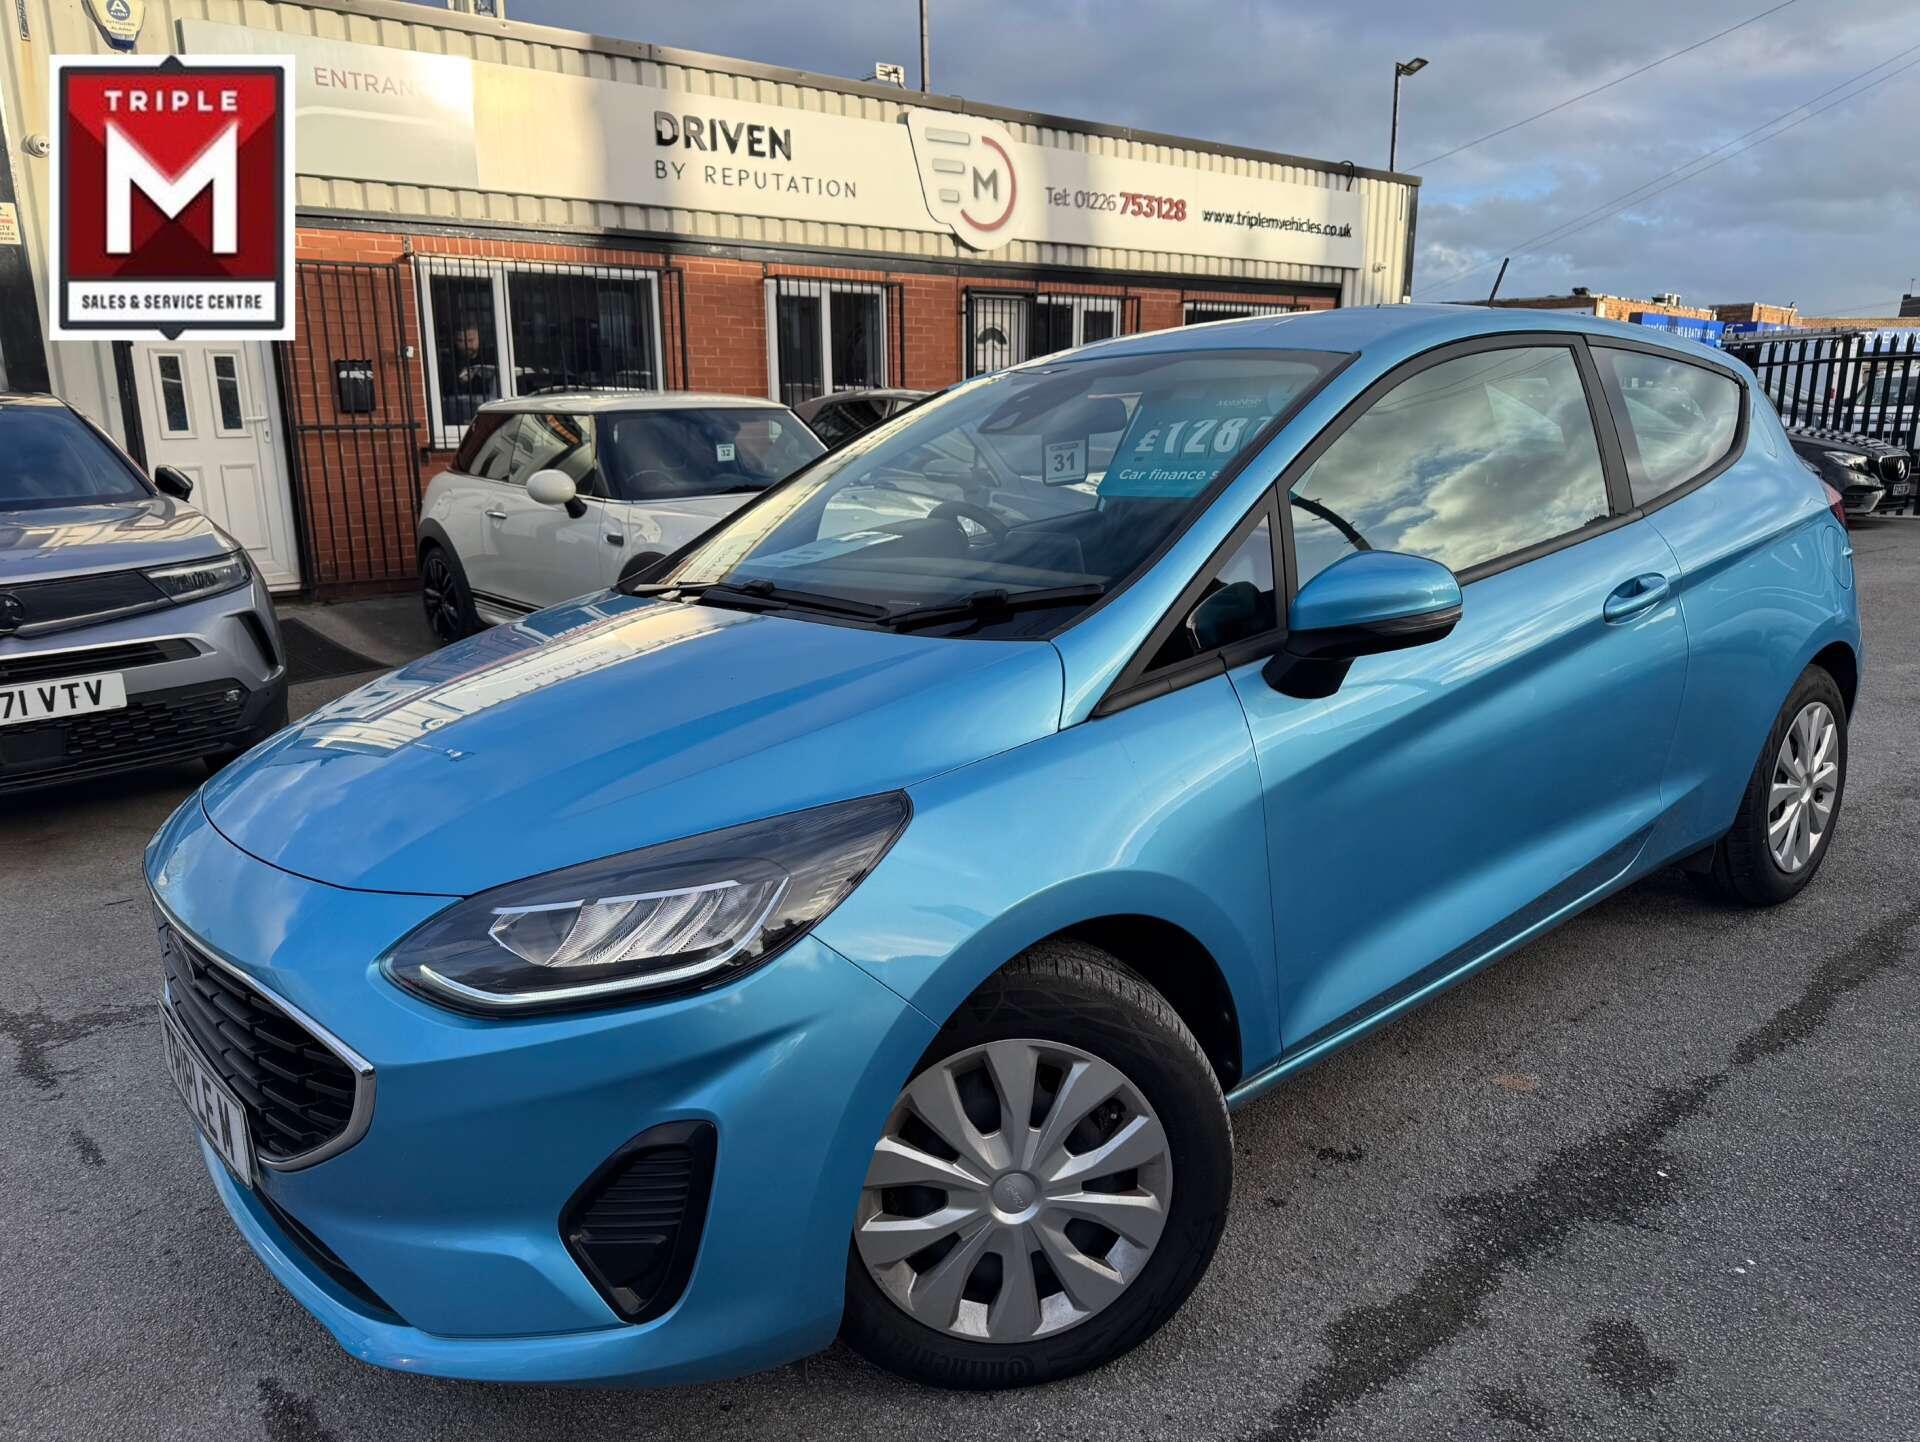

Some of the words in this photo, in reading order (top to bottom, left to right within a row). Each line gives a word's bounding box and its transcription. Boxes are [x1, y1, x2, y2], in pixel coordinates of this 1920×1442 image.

[313, 66, 417, 96] ENTRAN
[654, 110, 792, 161] DRIVEN
[655, 159, 687, 180] BY
[704, 165, 857, 198] REPUTATION
[972, 166, 999, 201] M
[1074, 190, 1117, 212] 01226
[1119, 191, 1188, 222] 753128
[1202, 209, 1352, 238] www.triplemvehicles.co.uk
[1053, 452, 1075, 472] 31
[1119, 468, 1146, 480] Car
[1149, 469, 1206, 480] finance
[37, 679, 102, 713] VTV
